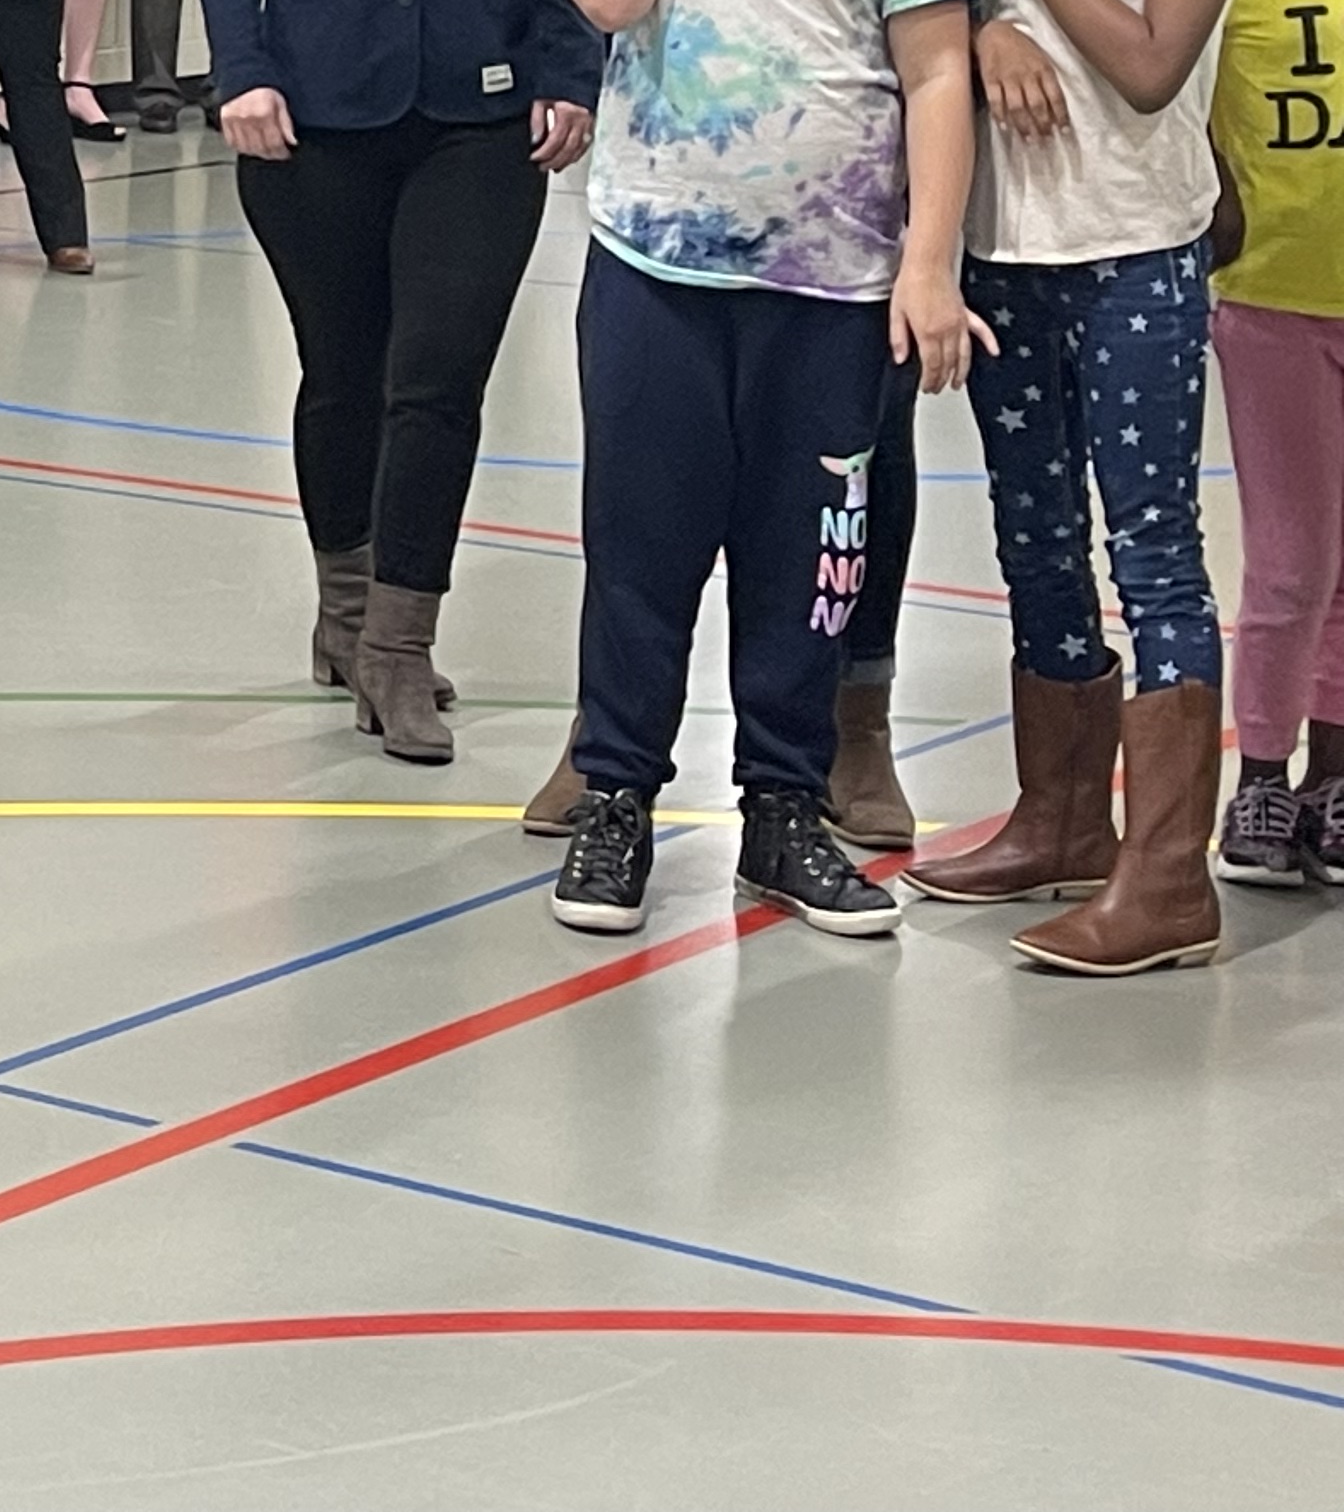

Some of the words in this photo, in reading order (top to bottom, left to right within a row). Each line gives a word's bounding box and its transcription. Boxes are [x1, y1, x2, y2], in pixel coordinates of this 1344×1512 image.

[1284, 5, 1336, 77] I
[1264, 90, 1344, 150] D
[820, 506, 867, 551] NO
[817, 551, 866, 595] NO
[810, 595, 858, 638] N
